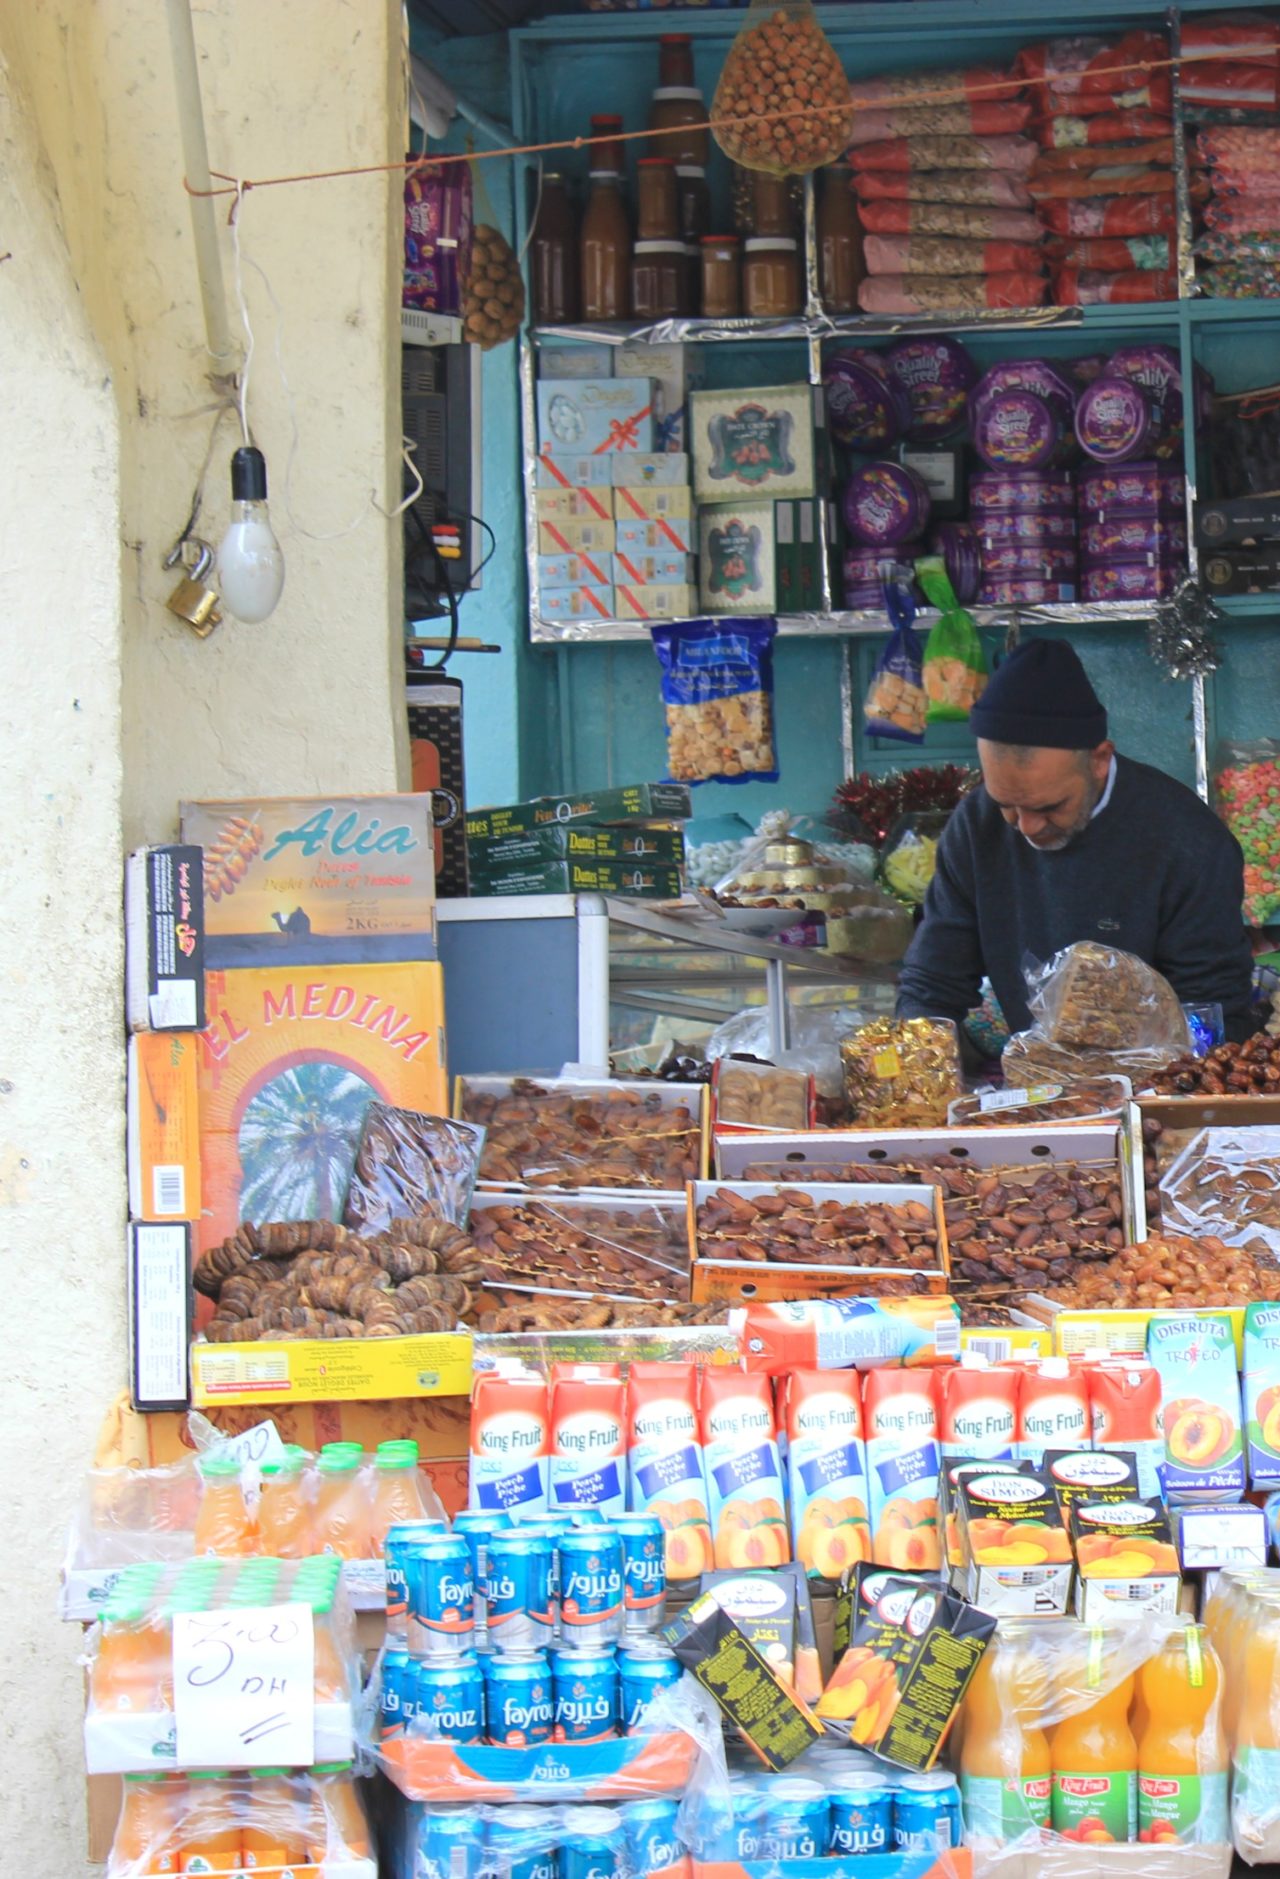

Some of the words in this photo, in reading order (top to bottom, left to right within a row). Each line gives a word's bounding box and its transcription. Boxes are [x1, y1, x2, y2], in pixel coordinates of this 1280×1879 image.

[262, 807, 419, 861] Alia
[569, 833, 596, 850] Dattes
[573, 866, 598, 883] Dattes
[201, 1009, 250, 1060] EL
[262, 984, 430, 1062] MEDINA
[1157, 1321, 1226, 1339] DISFRUTA
[1165, 1349, 1221, 1364] TROFEO
[634, 1419, 663, 1436] King
[665, 1412, 694, 1430] Fruit
[709, 1417, 738, 1433] King
[741, 1409, 770, 1428] Fruit
[797, 1413, 826, 1430] King
[829, 1406, 857, 1425] Fruit
[875, 1412, 904, 1431] King
[907, 1406, 935, 1425] Fruit
[953, 1418, 983, 1438] King
[986, 1411, 1013, 1433] Fruit
[1024, 1416, 1054, 1436] King
[1057, 1408, 1084, 1430] Fruit
[480, 1431, 508, 1452] King
[511, 1425, 542, 1448] Fruit
[556, 1431, 586, 1452] King
[589, 1424, 620, 1447] Fruit
[981, 1487, 1037, 1497] SIMON
[992, 1480, 1022, 1488] DON
[1197, 1478, 1207, 1487] de
[1209, 1474, 1241, 1487] Pêche
[565, 1567, 621, 1598] فيروز
[556, 1695, 610, 1724] فيروز
[528, 1762, 570, 1781] فيروز
[832, 1823, 886, 1853] فيروز
